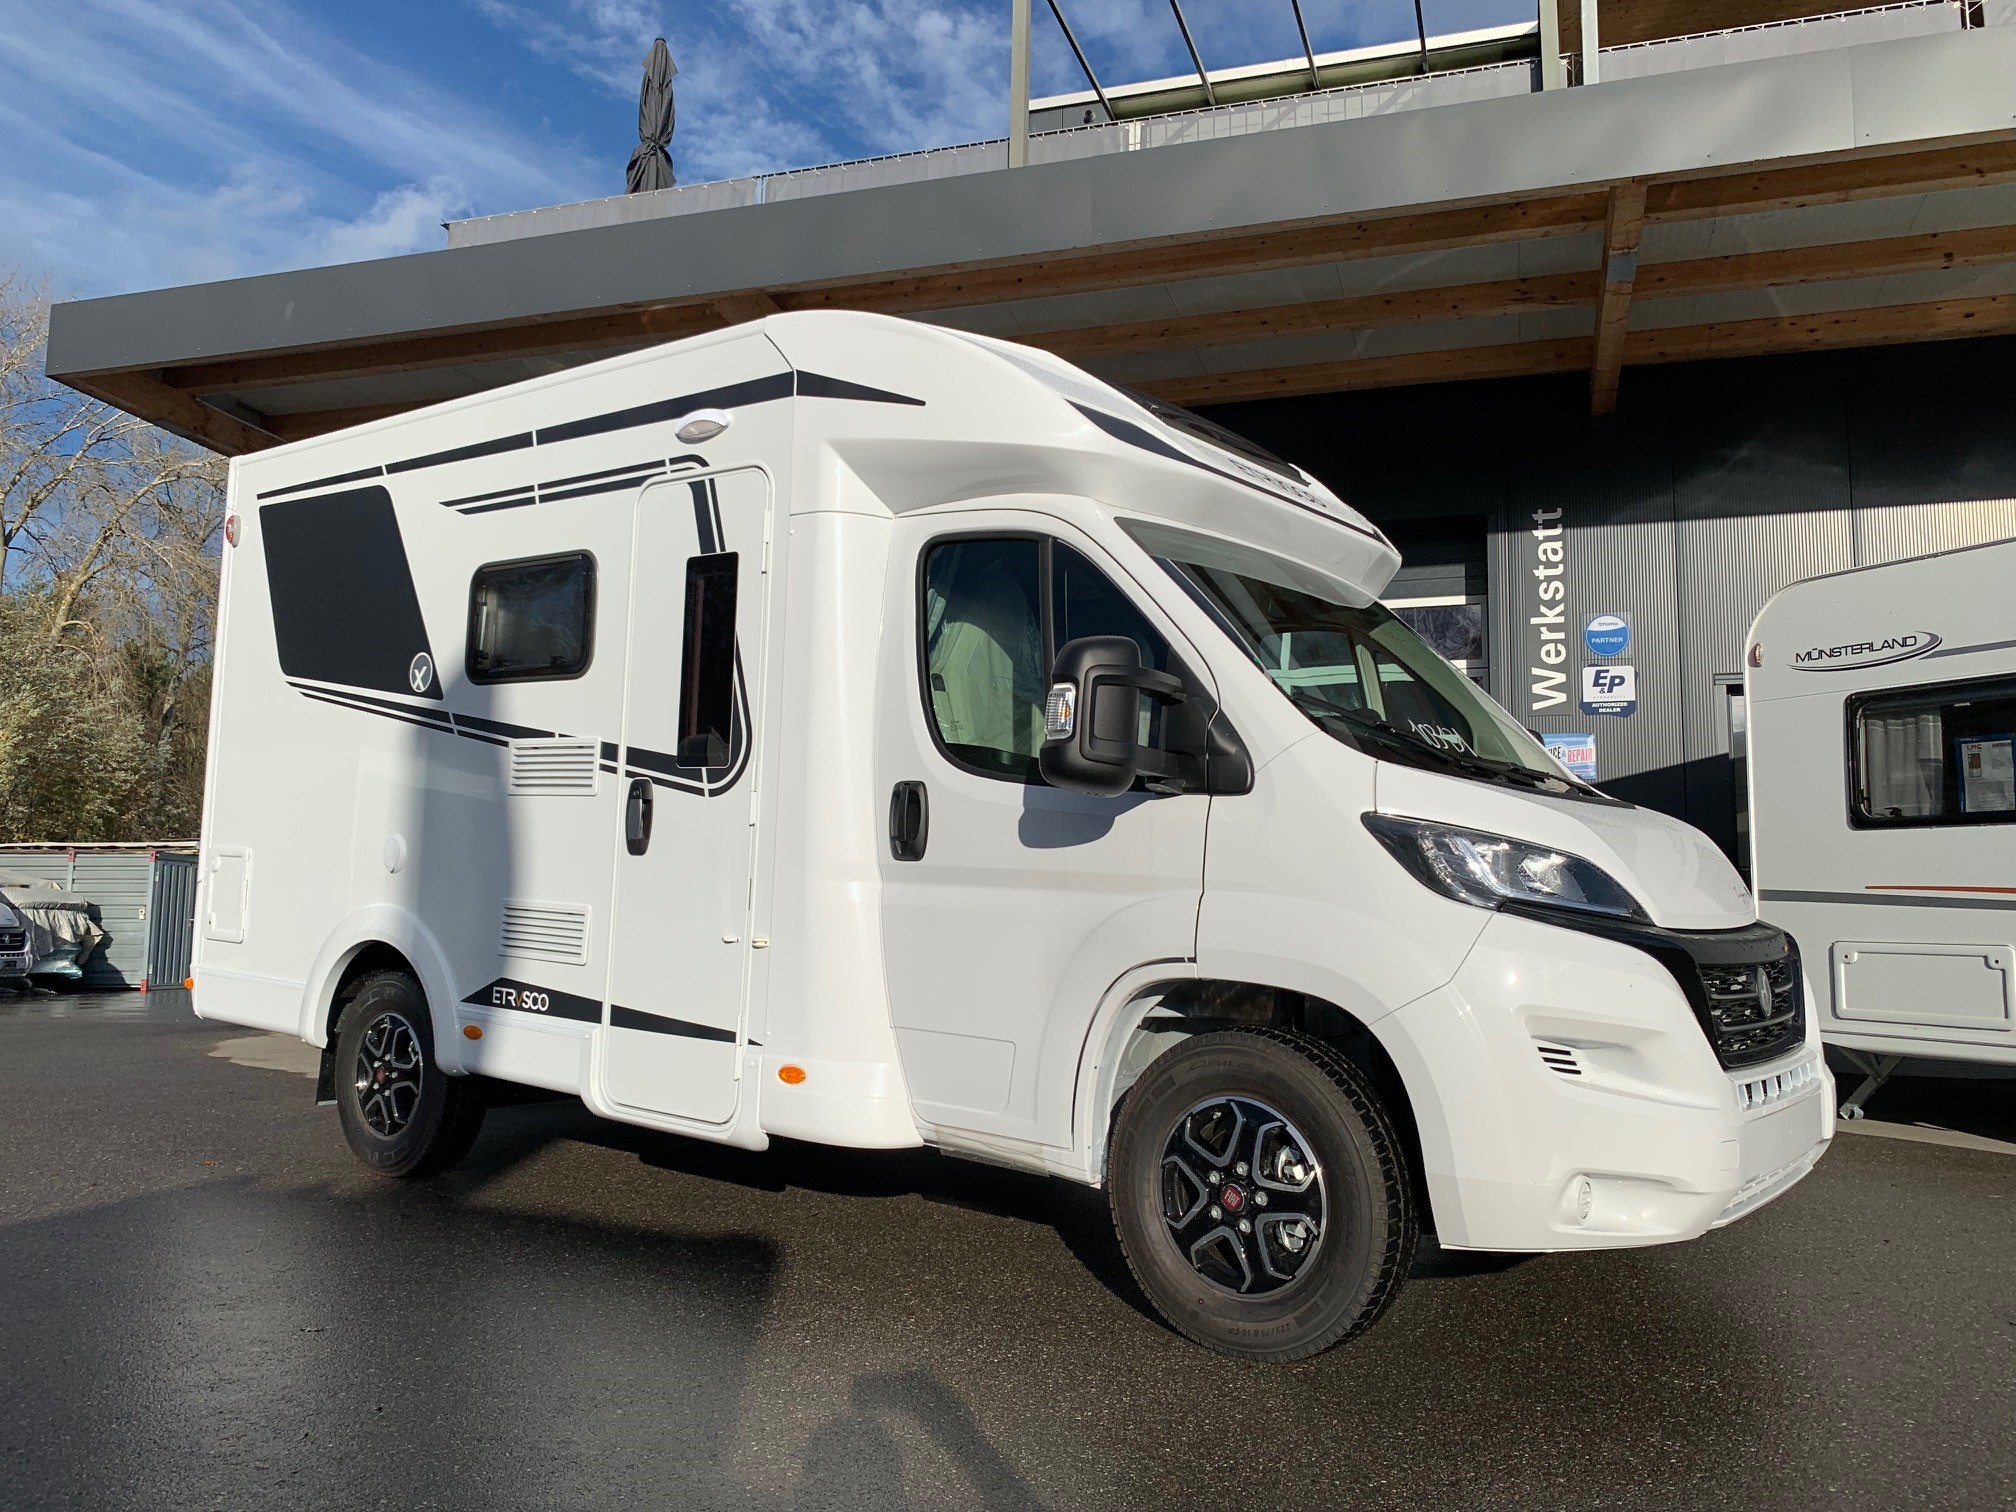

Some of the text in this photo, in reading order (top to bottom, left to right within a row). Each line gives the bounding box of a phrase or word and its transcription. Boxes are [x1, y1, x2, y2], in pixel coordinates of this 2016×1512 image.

[1530, 507, 1566, 710] Werkstatt
[1591, 636, 1624, 644] PARTNER
[1795, 635, 1918, 664] MÜNSTERLAND
[1567, 747, 1593, 763] REPAIR
[1224, 1189, 1241, 1208] FIAT
